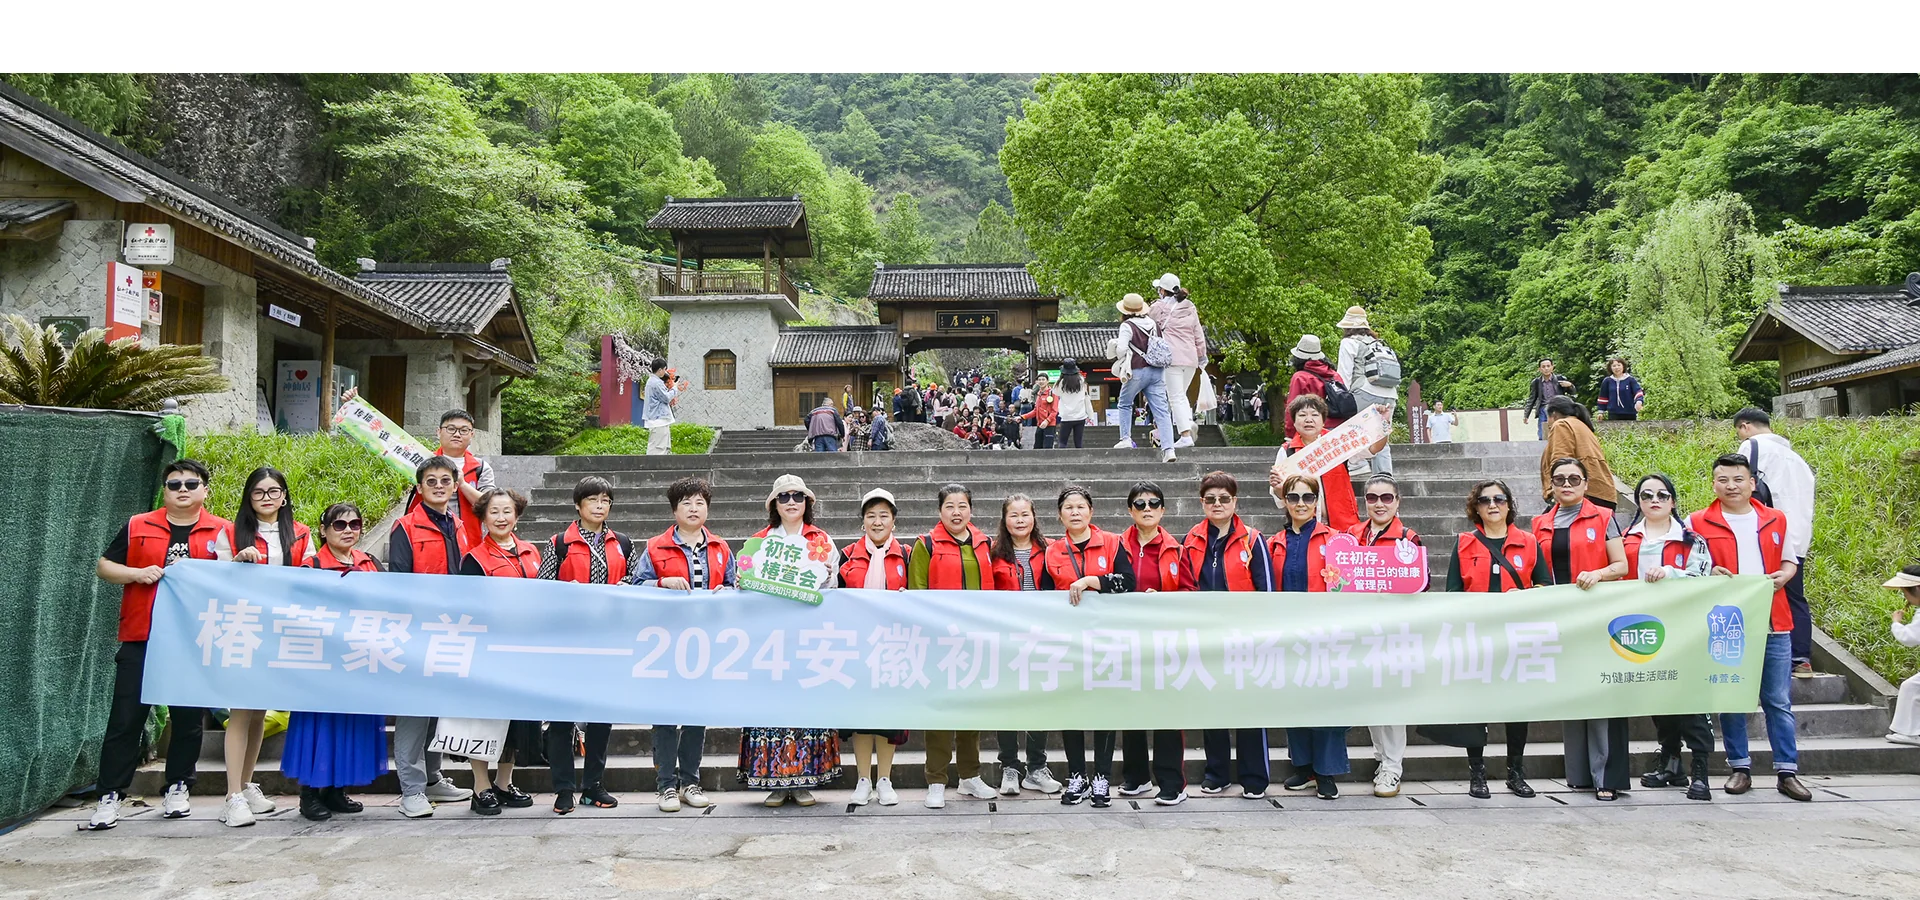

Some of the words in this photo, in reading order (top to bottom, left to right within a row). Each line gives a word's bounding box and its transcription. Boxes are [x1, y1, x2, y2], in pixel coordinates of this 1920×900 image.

[764, 538, 803, 563] 初存
[760, 559, 818, 589] 椿萱会
[1353, 566, 1420, 578] 做自己的健康
[1620, 628, 1657, 645] 初存
[1600, 669, 1679, 684] 为健康生活赋能
[434, 734, 490, 755] HUIZI
